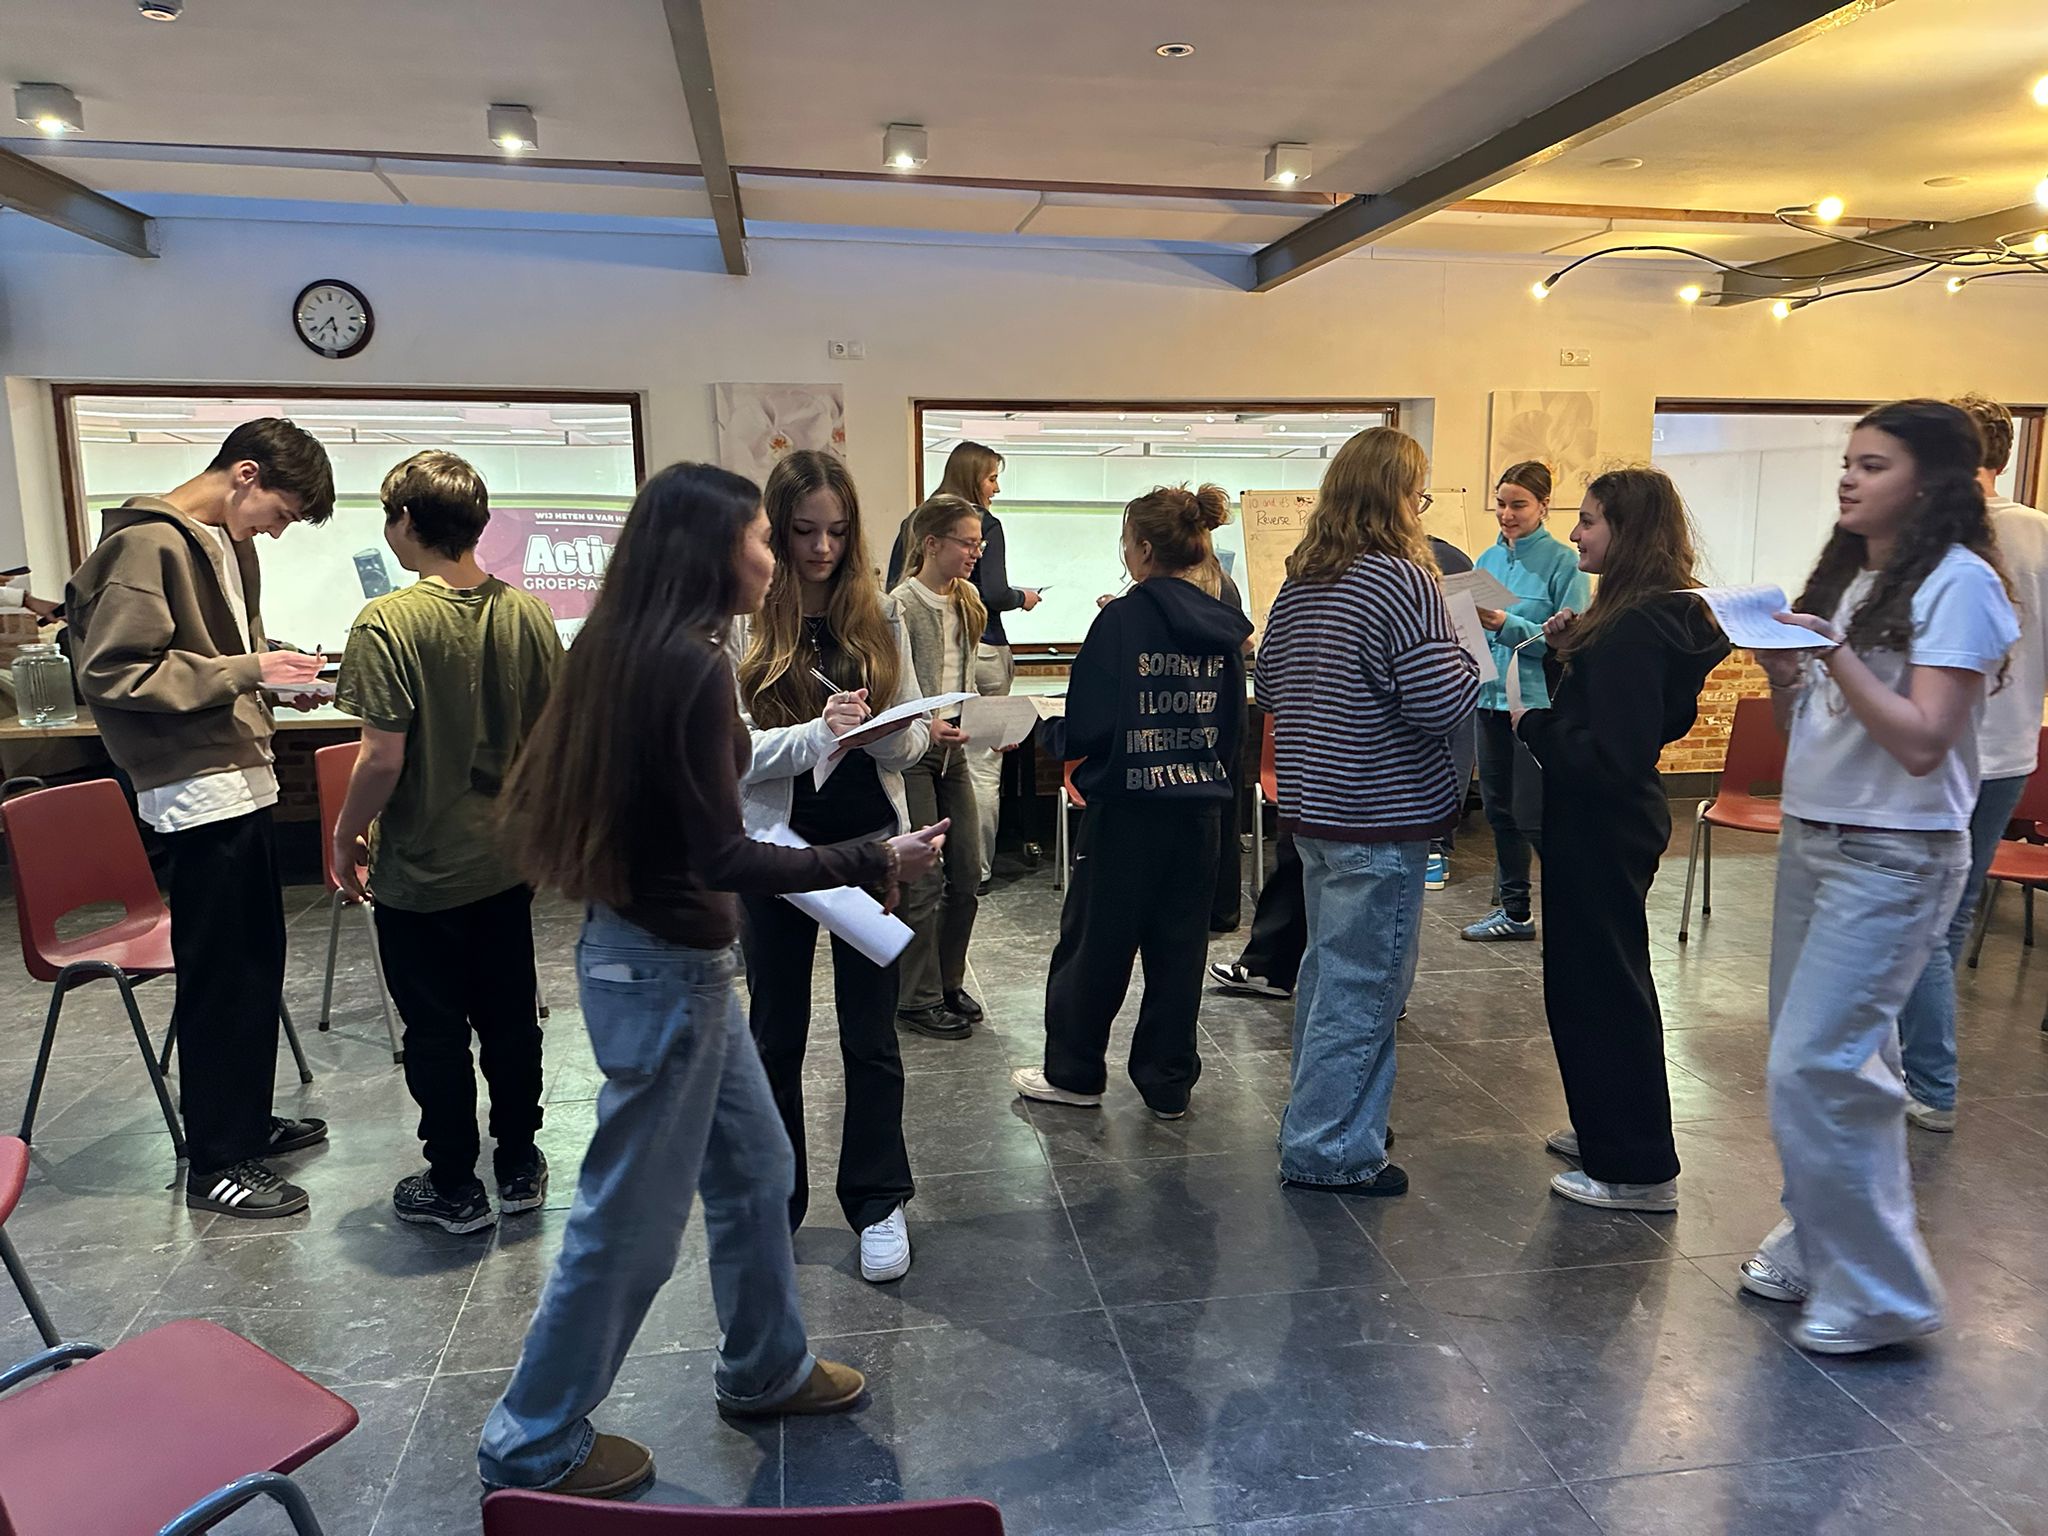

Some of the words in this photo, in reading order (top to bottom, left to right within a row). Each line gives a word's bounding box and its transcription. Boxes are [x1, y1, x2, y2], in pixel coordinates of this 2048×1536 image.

[535, 512, 553, 520] WIJ
[555, 512, 585, 521] HETEN
[587, 513, 594, 521] U
[595, 514, 613, 522] VAN
[1256, 510, 1292, 526] Reverse
[1138, 652, 1202, 677] SORRY
[1208, 655, 1225, 678] IF
[1139, 691, 1146, 715] I
[1148, 691, 1218, 715] LOOKED
[1126, 766, 1165, 791] BUT
[1166, 763, 1198, 786] I'M
